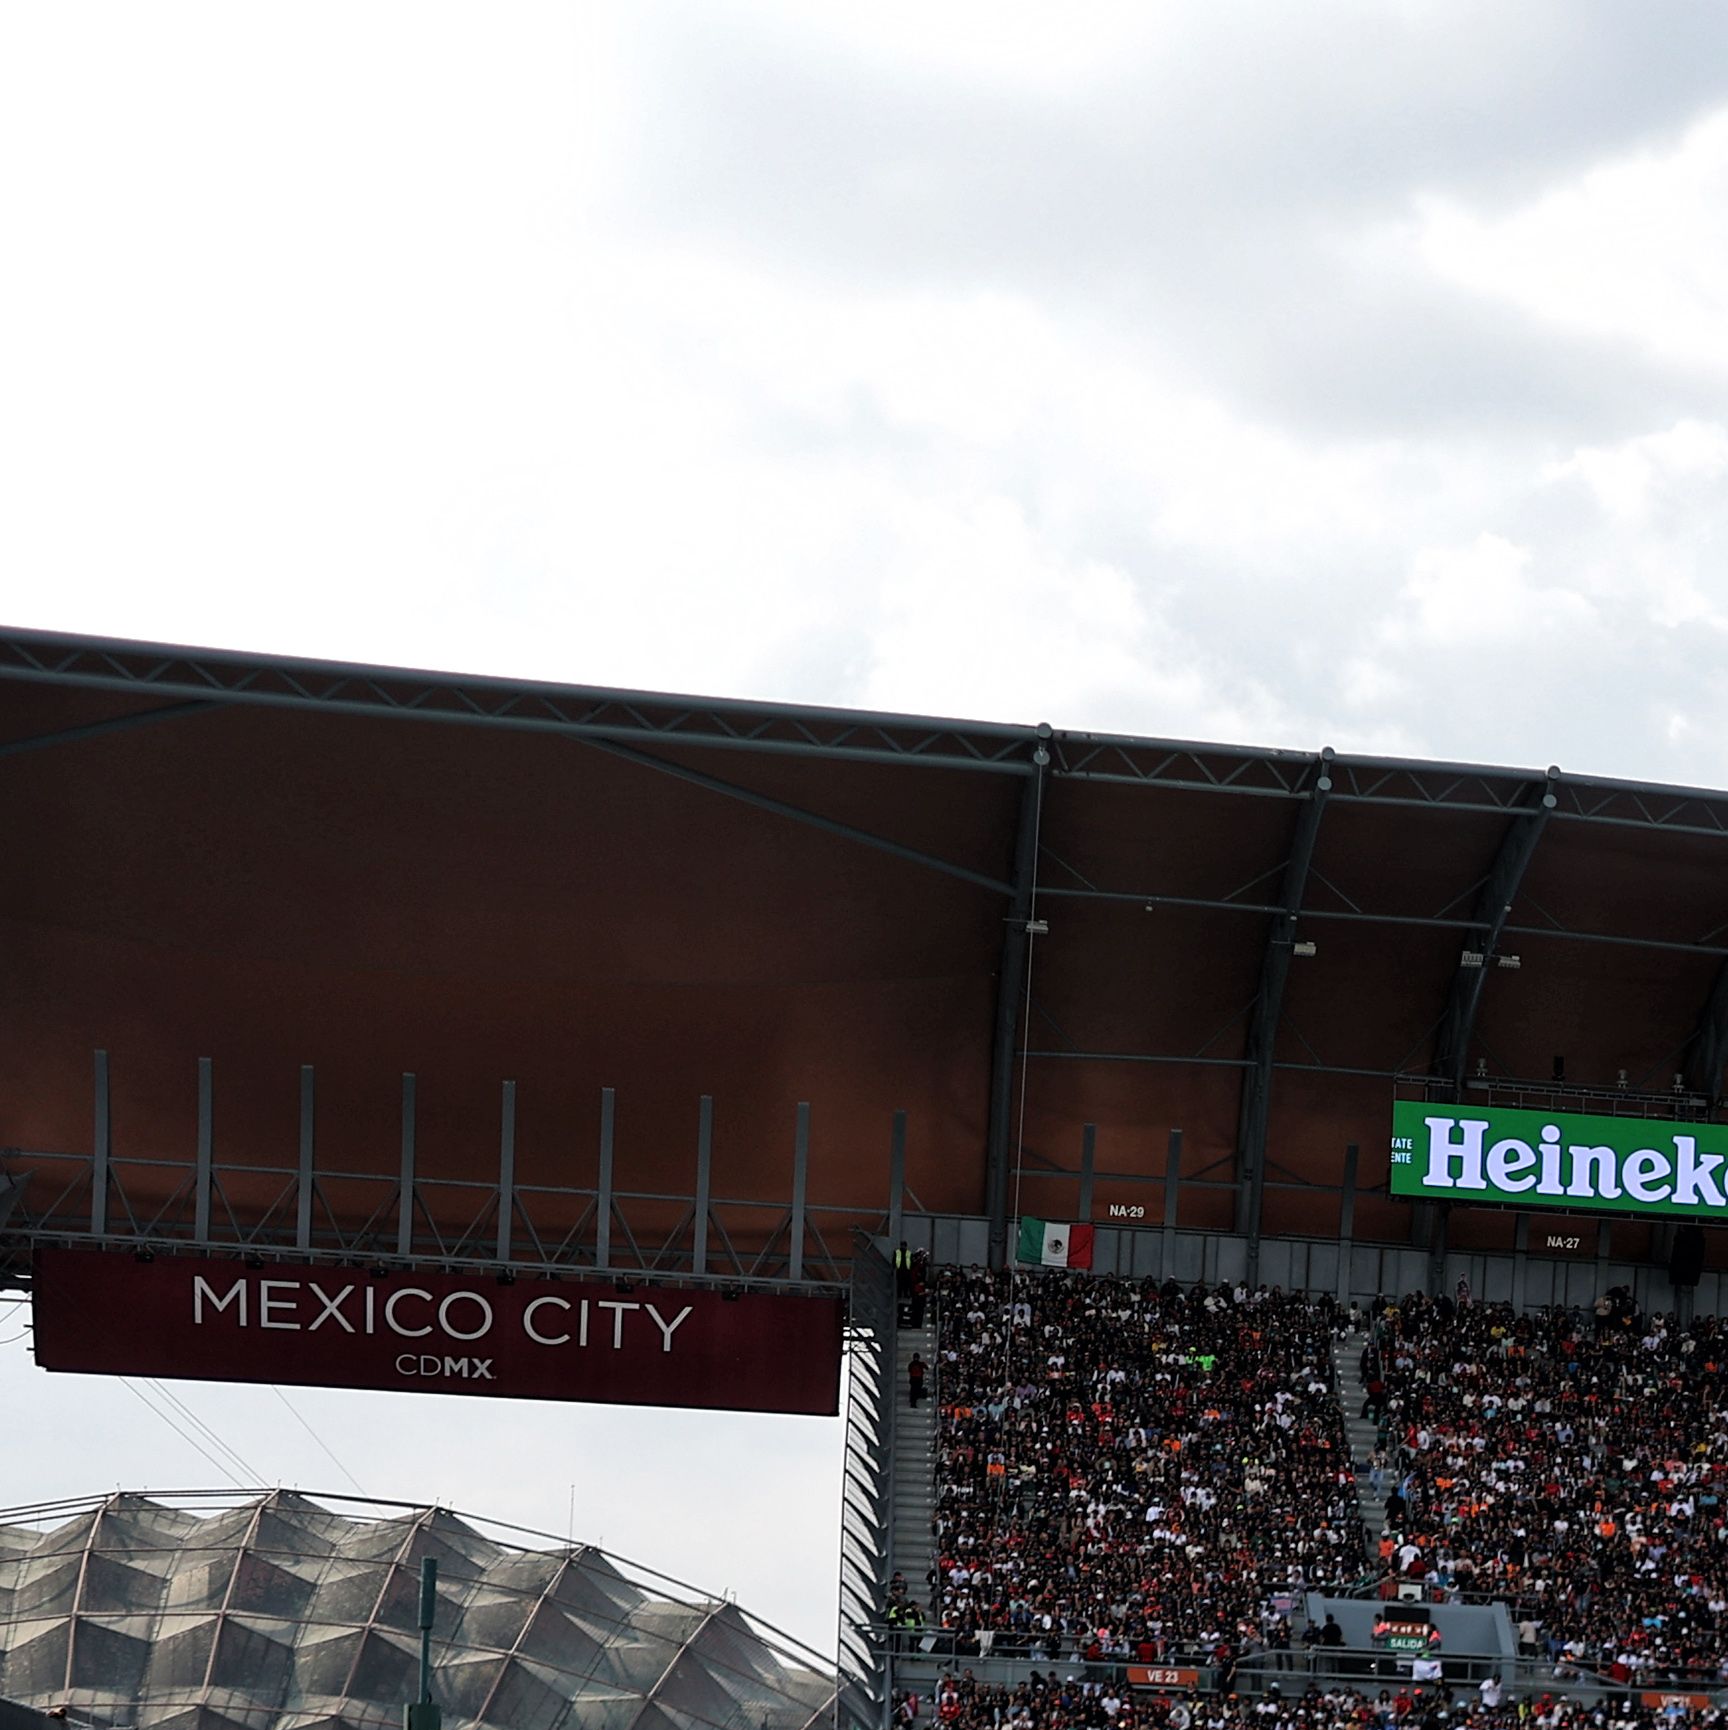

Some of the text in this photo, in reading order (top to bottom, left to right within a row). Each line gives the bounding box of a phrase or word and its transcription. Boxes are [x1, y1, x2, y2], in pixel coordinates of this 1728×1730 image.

[193, 1276, 694, 1353] MEXICO CITY
[396, 1353, 498, 1380] CDMX
[1390, 1637, 1424, 1649] SALIDA
